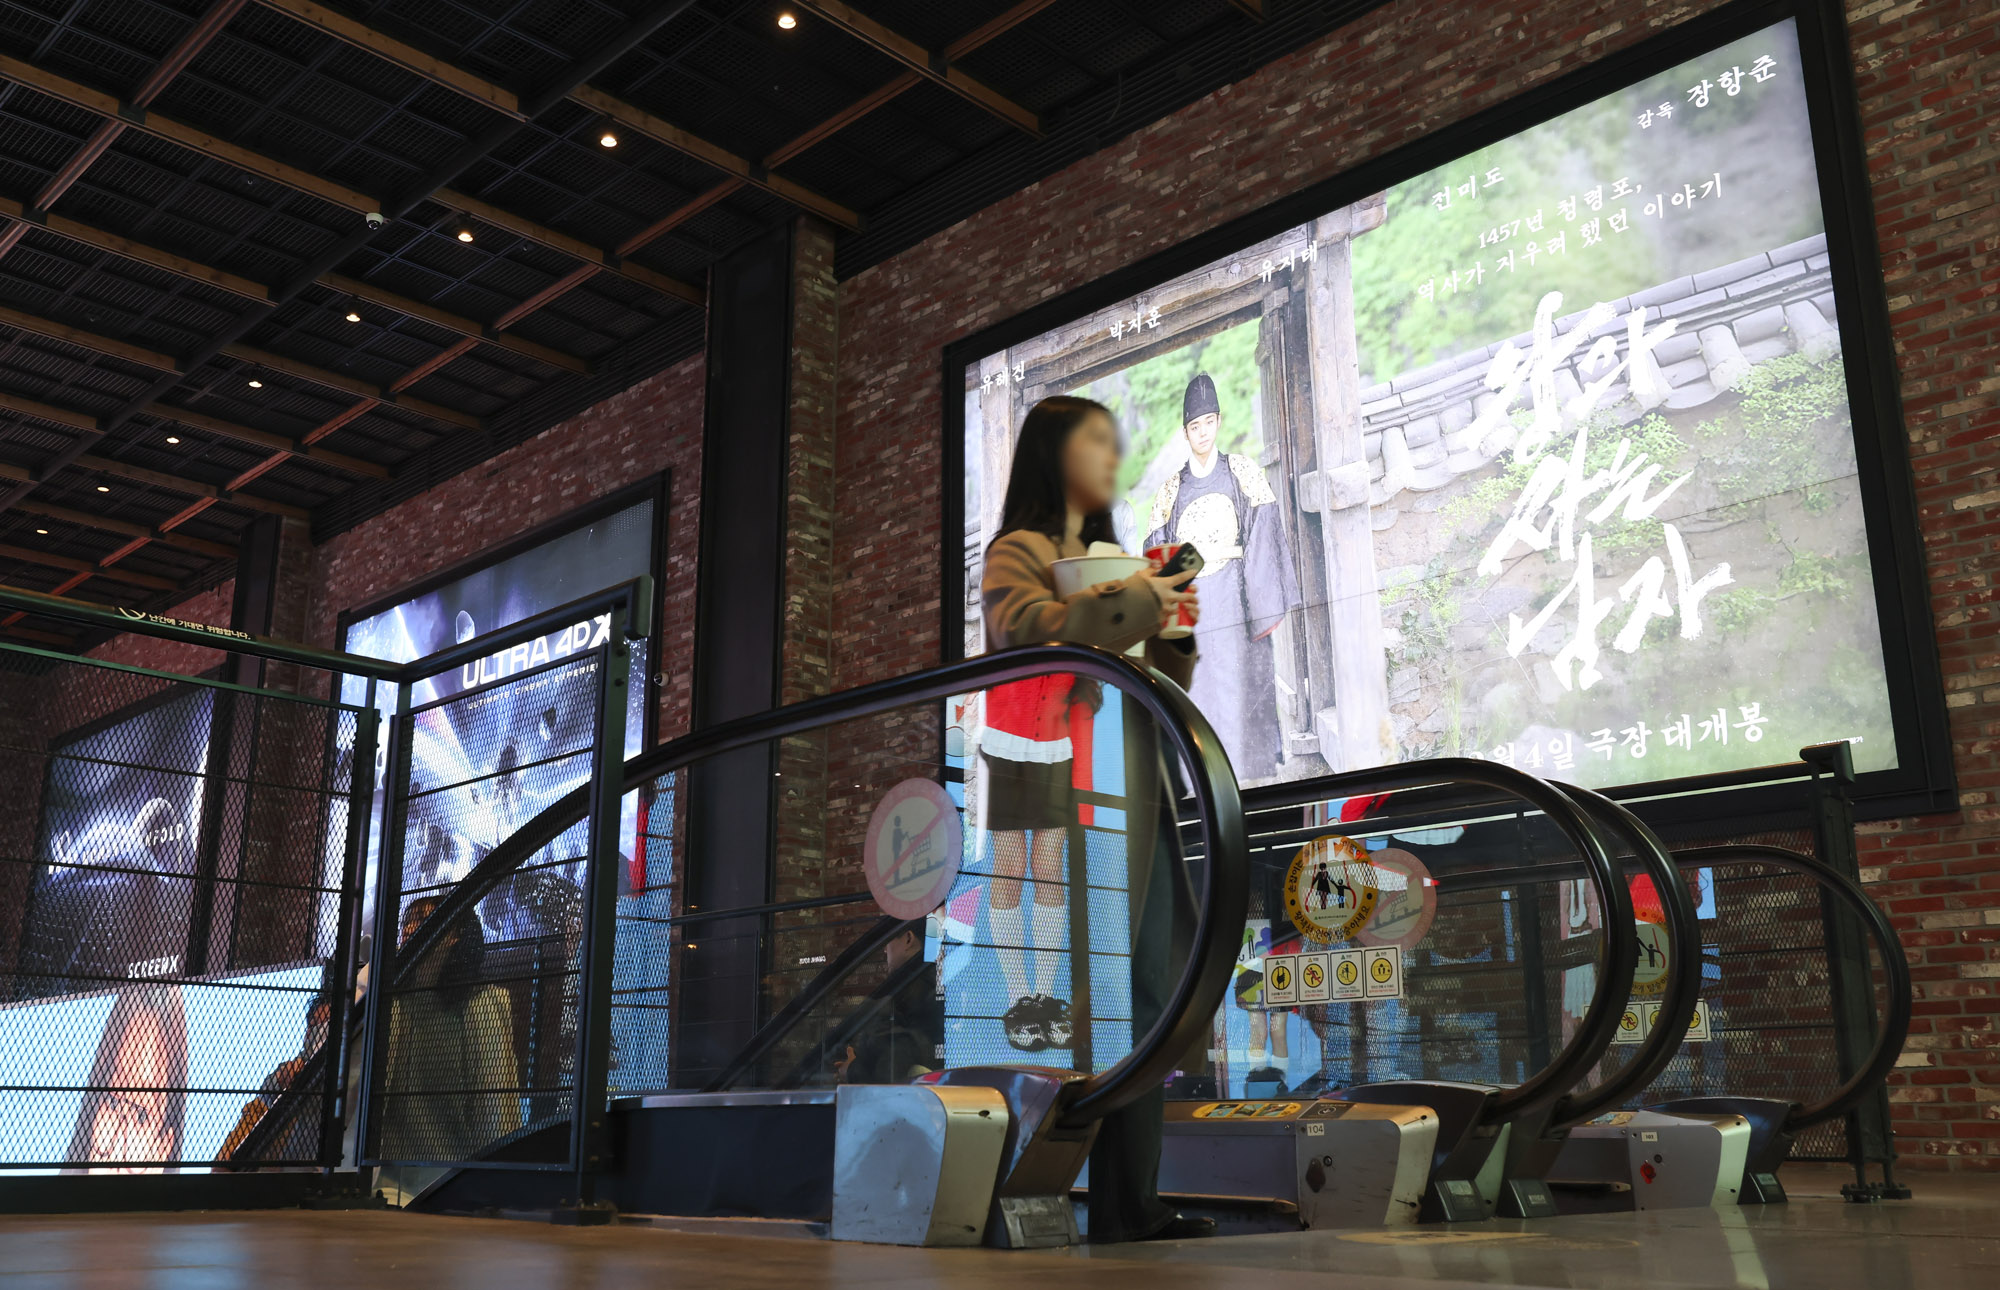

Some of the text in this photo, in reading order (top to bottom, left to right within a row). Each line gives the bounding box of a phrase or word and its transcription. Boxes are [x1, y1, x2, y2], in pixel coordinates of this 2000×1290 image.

[1637, 54, 1777, 130] 감독 장항준
[1431, 166, 1505, 212] 전미도
[1479, 176, 1643, 249] 1457년 청령포,
[1417, 172, 1722, 303] 역사가 지우려 했던 이야기
[1257, 240, 1318, 283] 유지태
[1109, 305, 1163, 342] 박지훈
[979, 361, 1026, 395] 유해진
[1477, 427, 1693, 577] 사는
[149, 613, 252, 641] 난간에 기대면 위험합니다.
[1506, 523, 1735, 692] 남자
[462, 612, 612, 690] ULTRA 4DX
[1523, 733, 1575, 771] 4일
[1584, 721, 1652, 762] 극장
[1660, 702, 1770, 750] 대개봉
[1287, 858, 1304, 893] 손잡이는
[127, 954, 179, 979] SCREENX
[1307, 1125, 1324, 1134] 104
